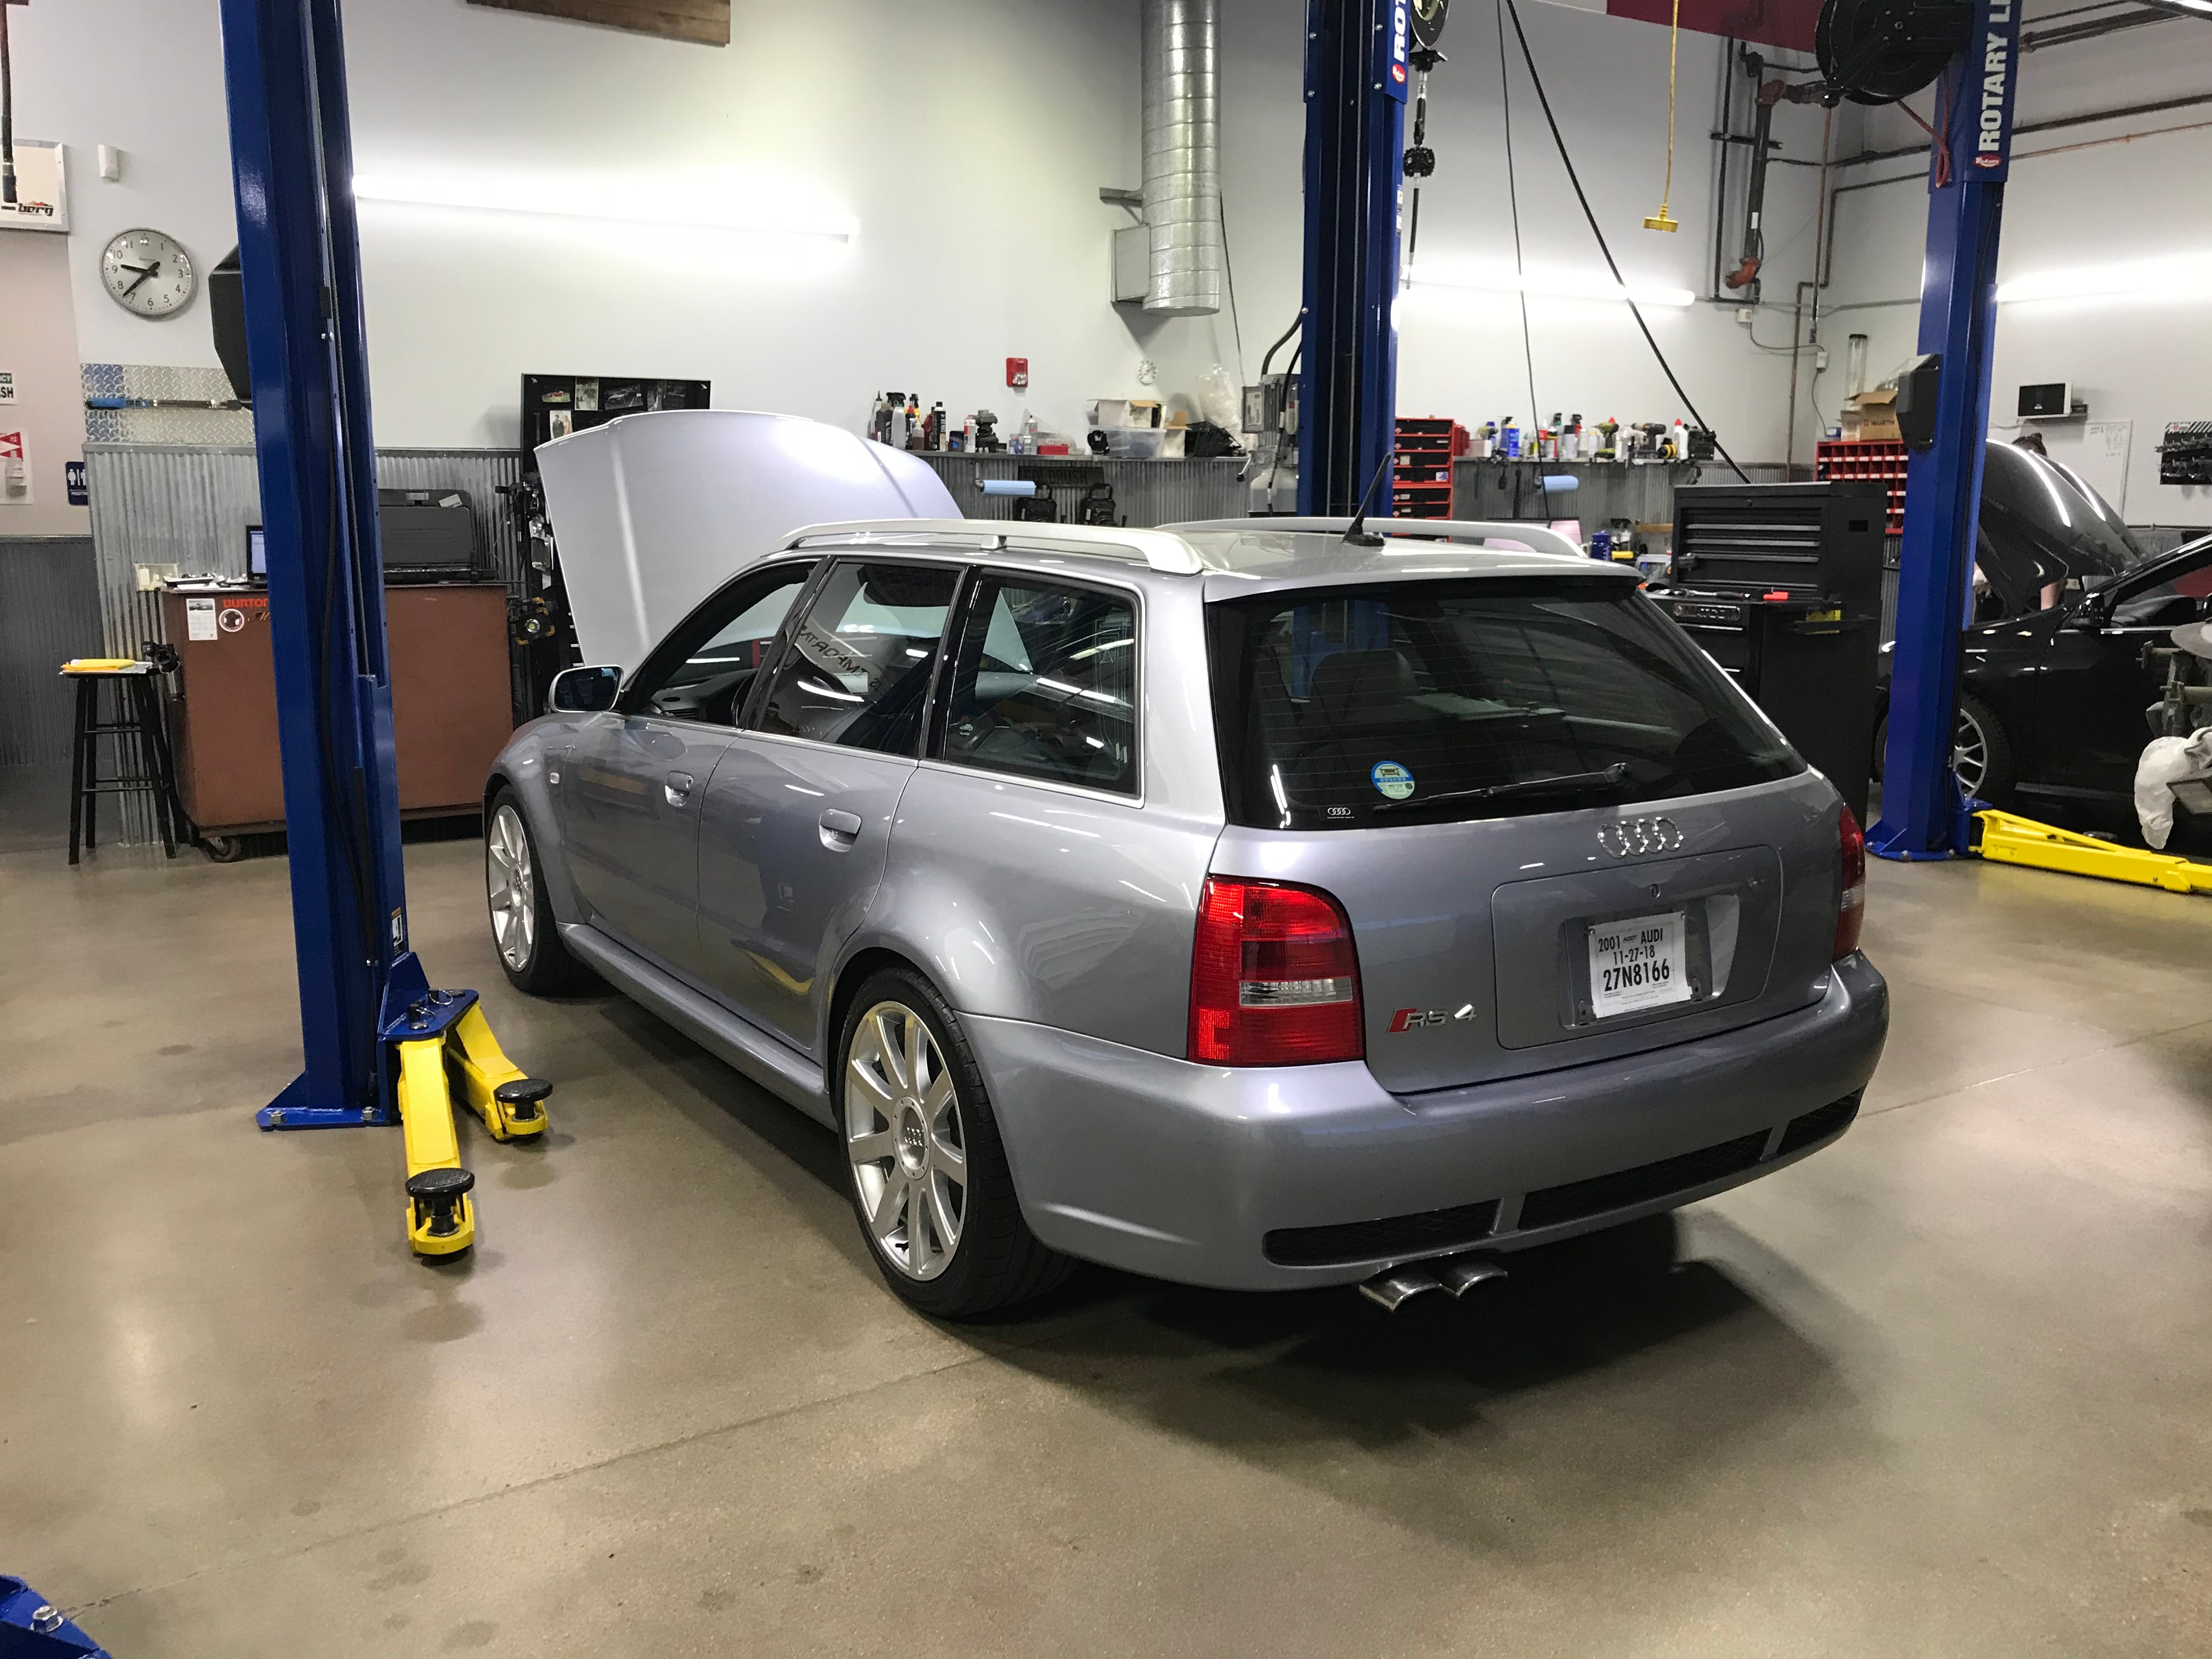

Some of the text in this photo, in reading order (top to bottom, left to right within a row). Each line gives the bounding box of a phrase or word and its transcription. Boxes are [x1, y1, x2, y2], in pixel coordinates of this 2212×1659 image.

[1394, 0, 1406, 63] RO
[1979, 32, 2008, 151] ROTARY
[113, 250, 123, 259] 10
[172, 255, 178, 263] 2
[112, 265, 117, 273] 9
[178, 269, 184, 278] 3
[117, 280, 123, 289] 8
[131, 292, 136, 301] 7
[163, 294, 170, 303] 5
[148, 297, 154, 306] 6
[0, 387, 14, 398] SH
[1598, 935, 1621, 952] 2001
[1641, 928, 1663, 945] AUDI
[1613, 945, 1655, 966] 11-27-18
[1603, 958, 1670, 992] 27N8166
